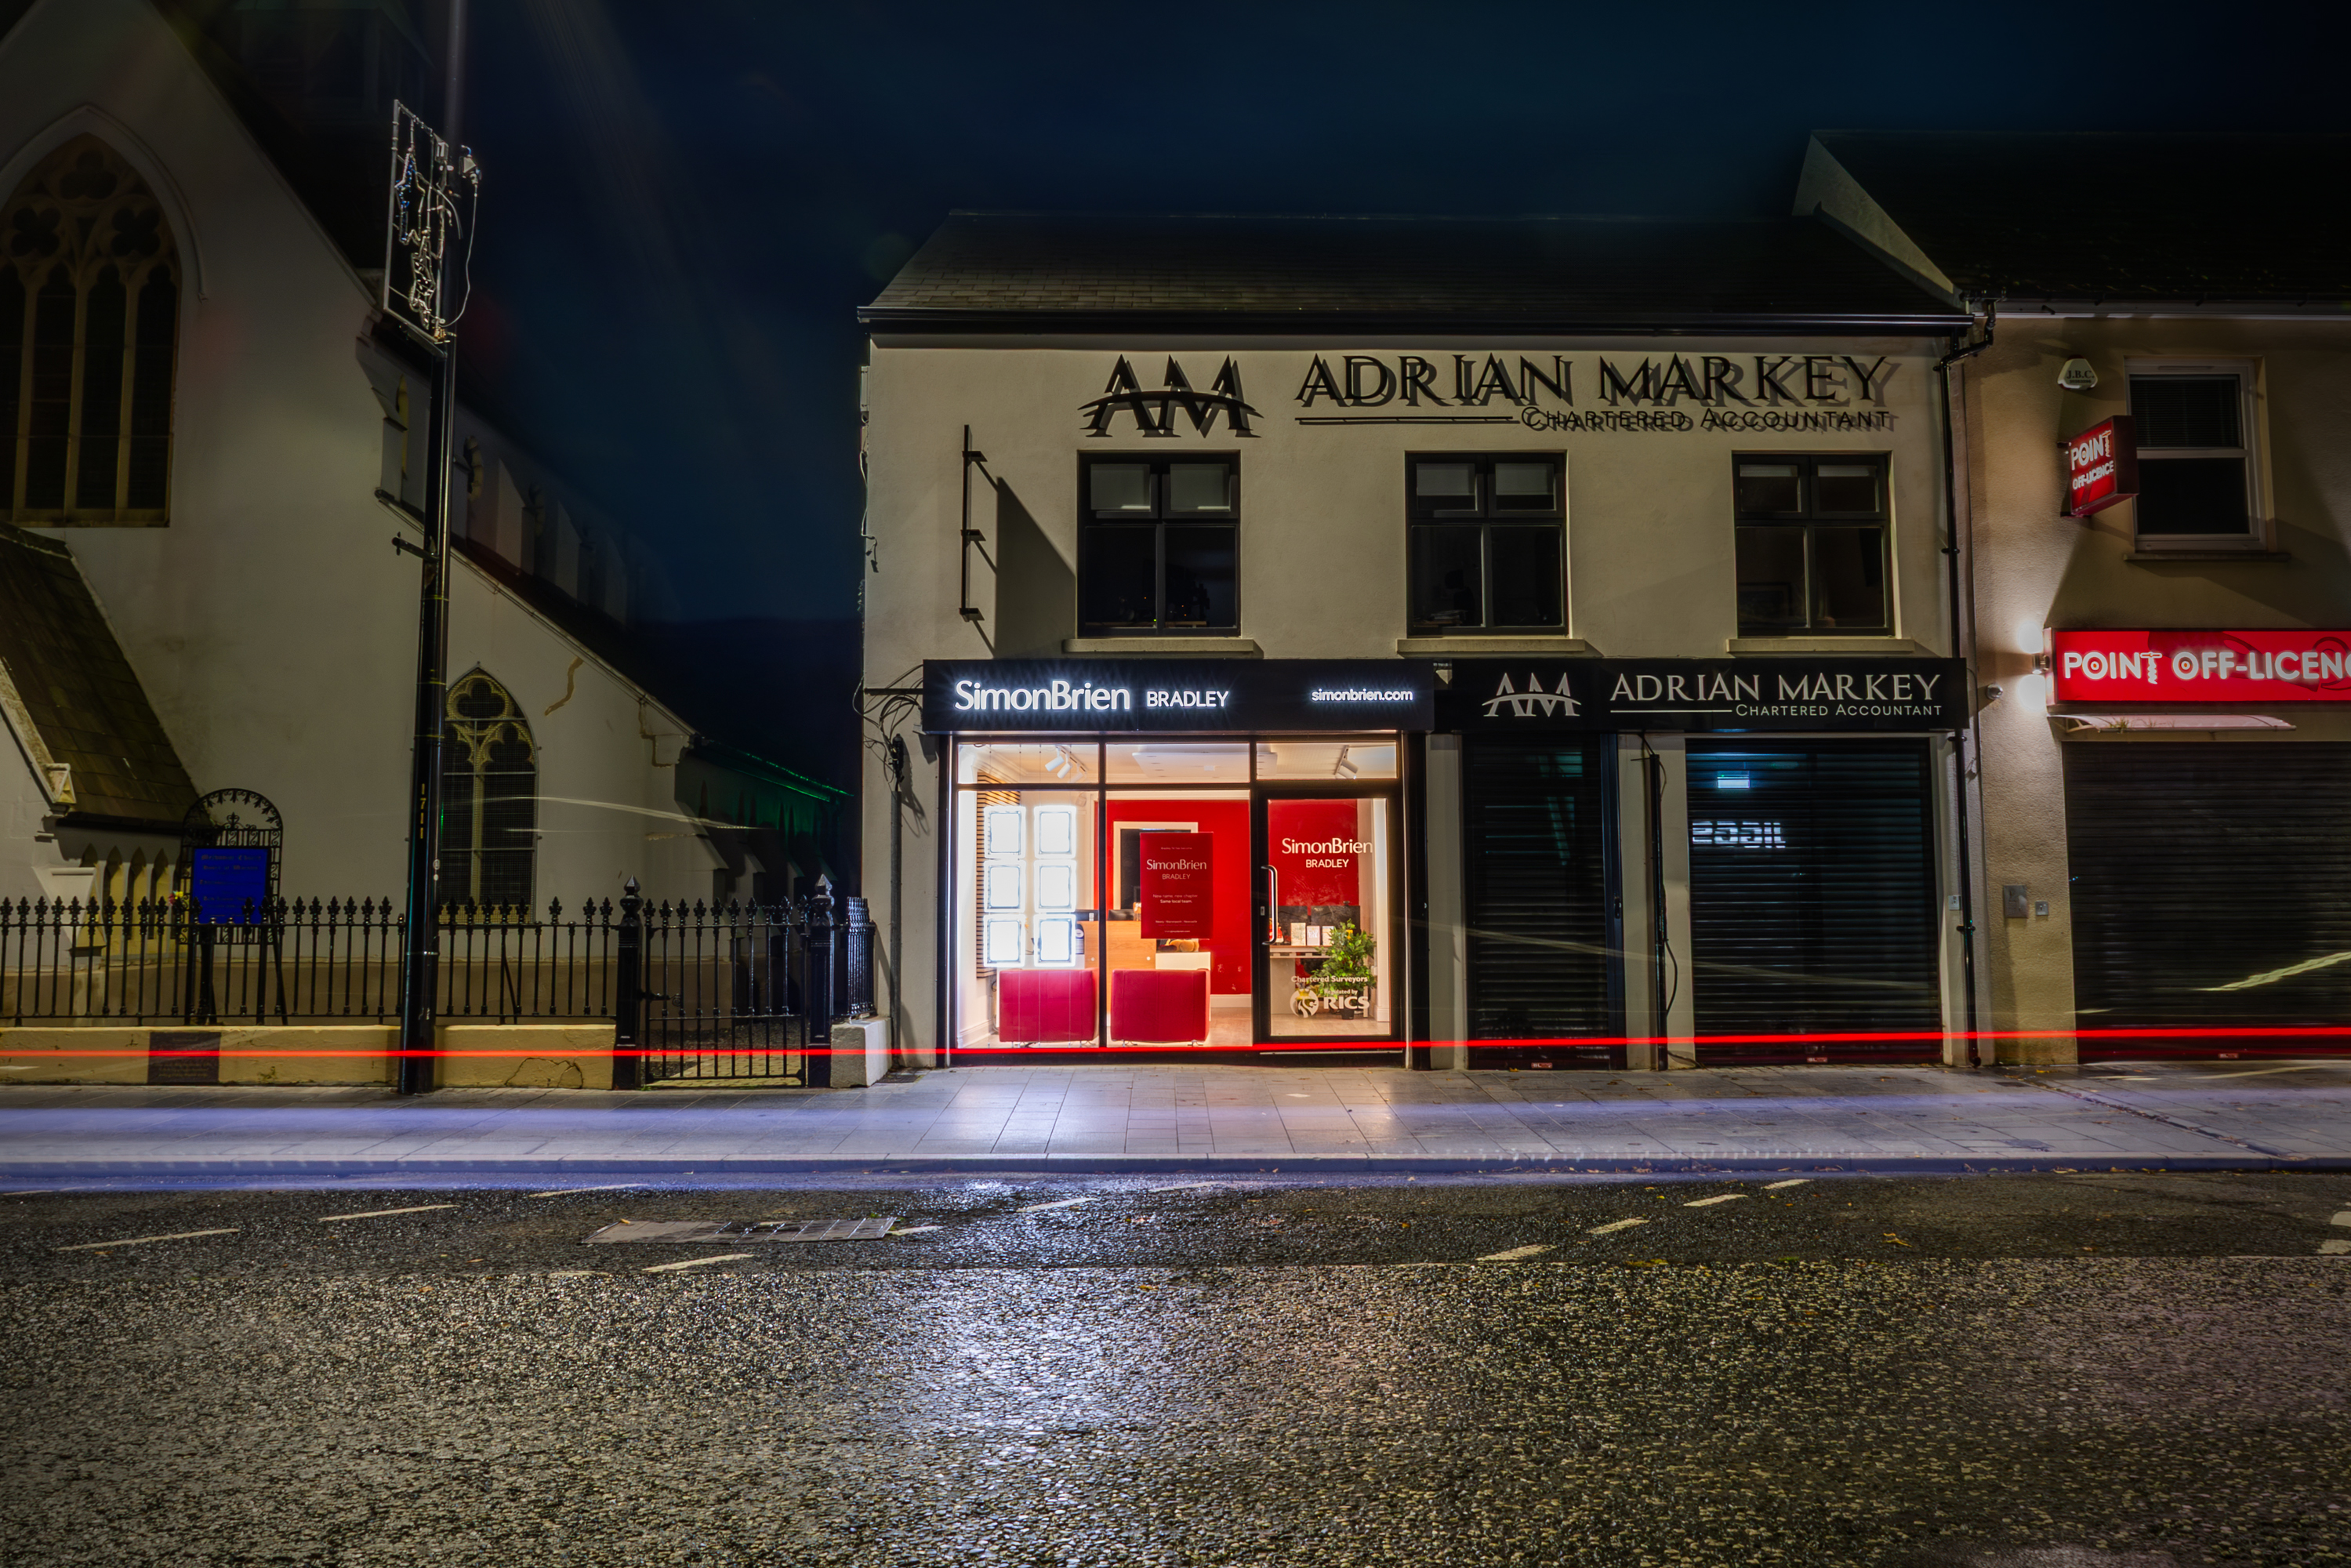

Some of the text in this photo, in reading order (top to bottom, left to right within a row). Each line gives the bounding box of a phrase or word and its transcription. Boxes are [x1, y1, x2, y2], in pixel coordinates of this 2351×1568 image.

[1294, 353, 1888, 401] ADRIAN MARKEY
[2066, 369, 2095, 379] J.B.C.
[1521, 406, 1890, 427] CHARTERED ACCOUNTANT
[2070, 430, 2111, 470] POINT
[2072, 460, 2114, 490] OFF-LICENCE
[2064, 651, 2351, 684] POINT OFF-LICEN
[954, 680, 1229, 710] SimonBrien BRADLEY
[1311, 688, 1413, 702] simonbrien.com
[1609, 672, 1941, 701] ADRIAN MARKEY
[1736, 703, 1942, 717] CHARTERED ACCOUNTANT
[1282, 838, 1373, 855] SimonBrien
[1146, 858, 1207, 870] SimonBrien
[1305, 859, 1349, 868] BRADLEY
[1330, 975, 1368, 984] Surveyors
[1323, 995, 1370, 1010] RICS
